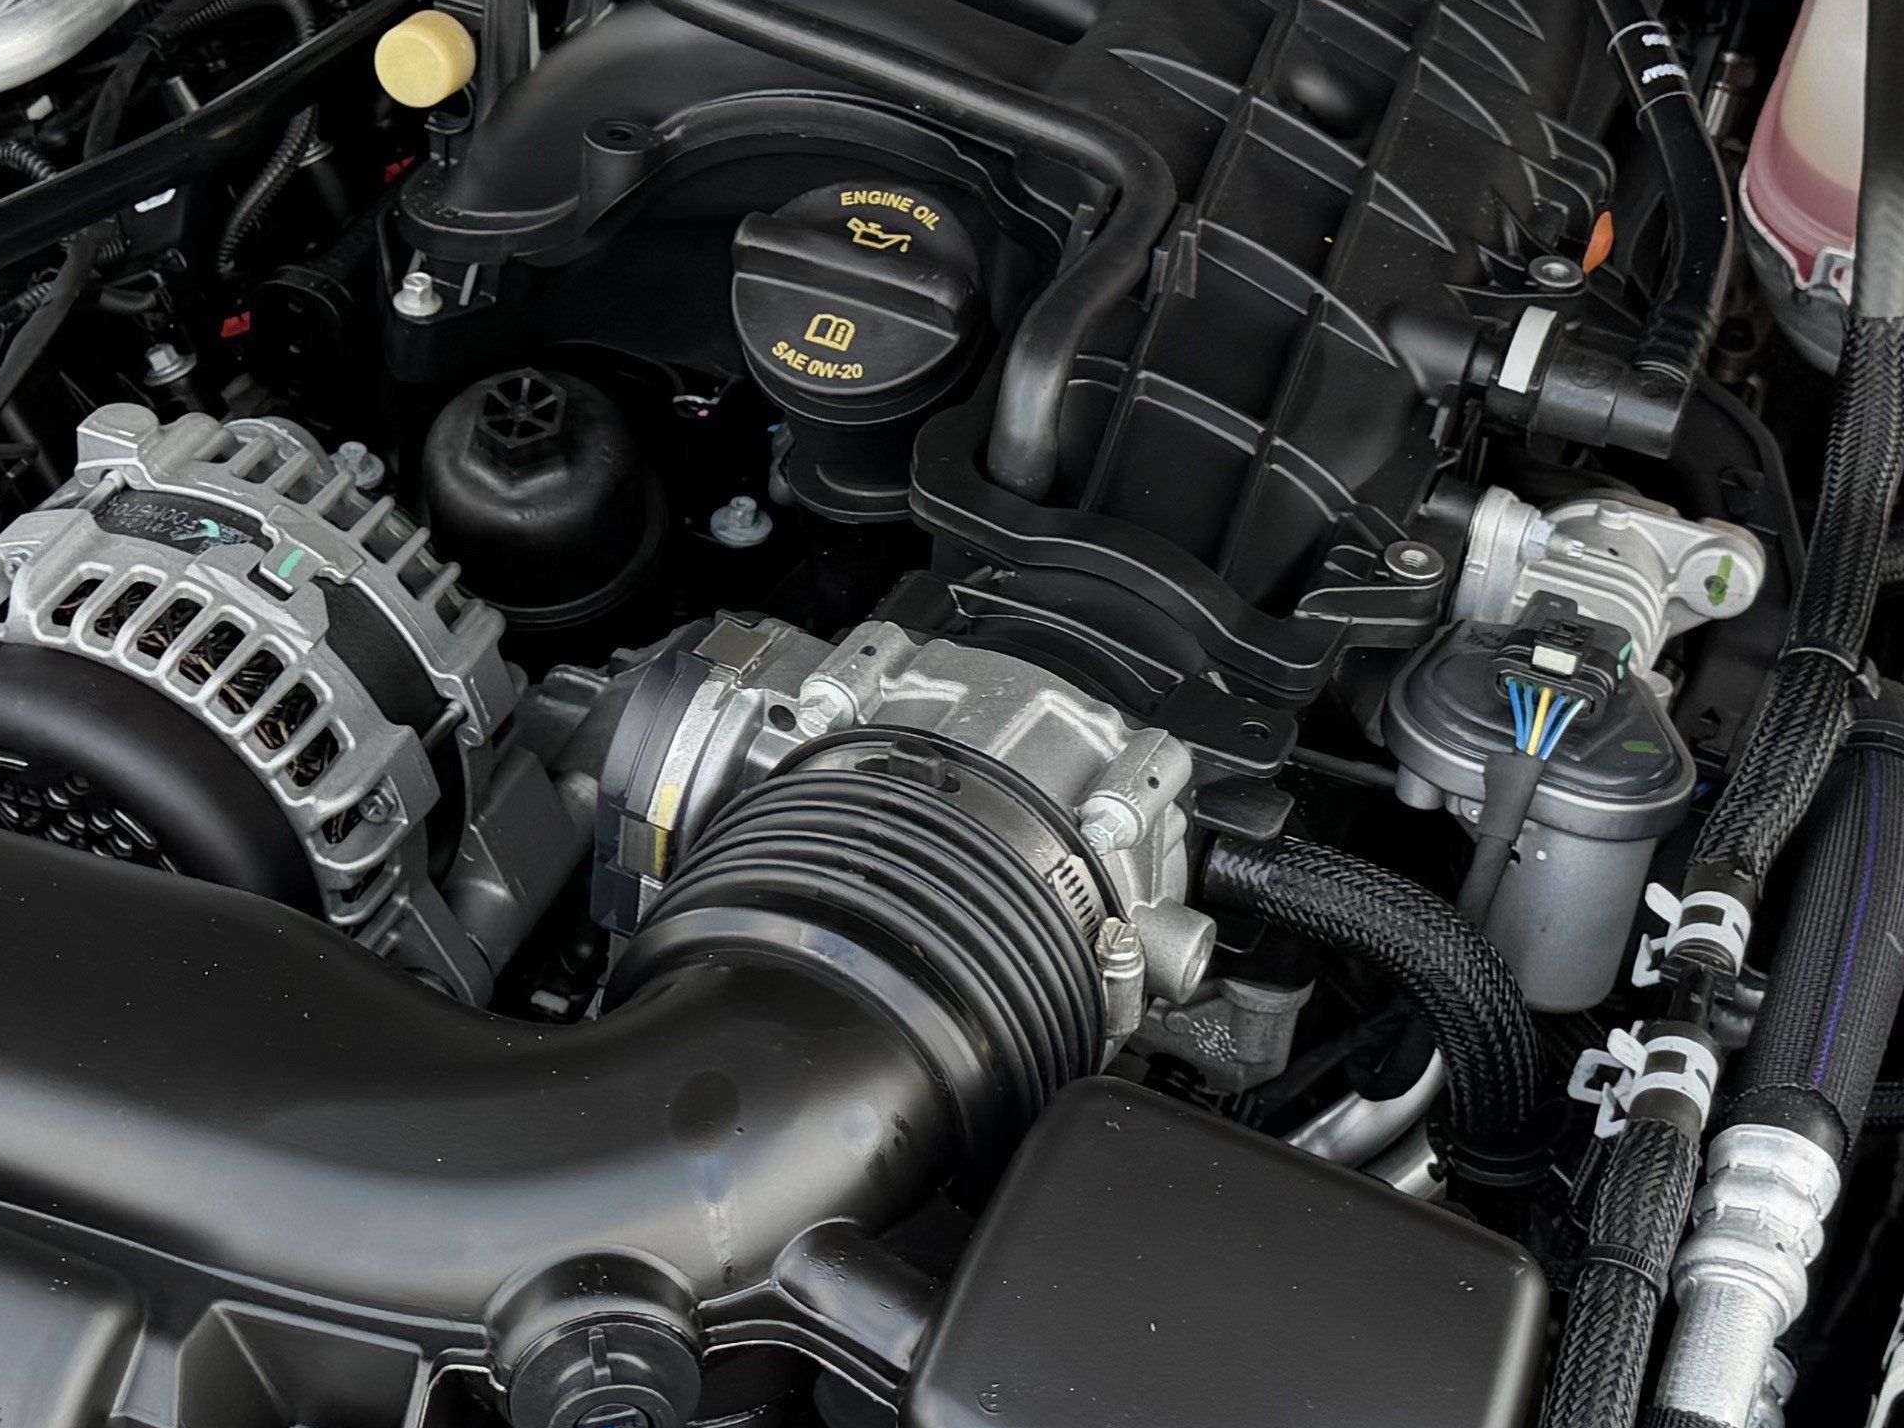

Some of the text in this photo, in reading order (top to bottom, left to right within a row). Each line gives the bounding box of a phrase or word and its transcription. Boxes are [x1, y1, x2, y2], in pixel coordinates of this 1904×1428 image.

[840, 190, 941, 231] ENGINE OIL
[771, 340, 863, 380] SAE 0W-20
